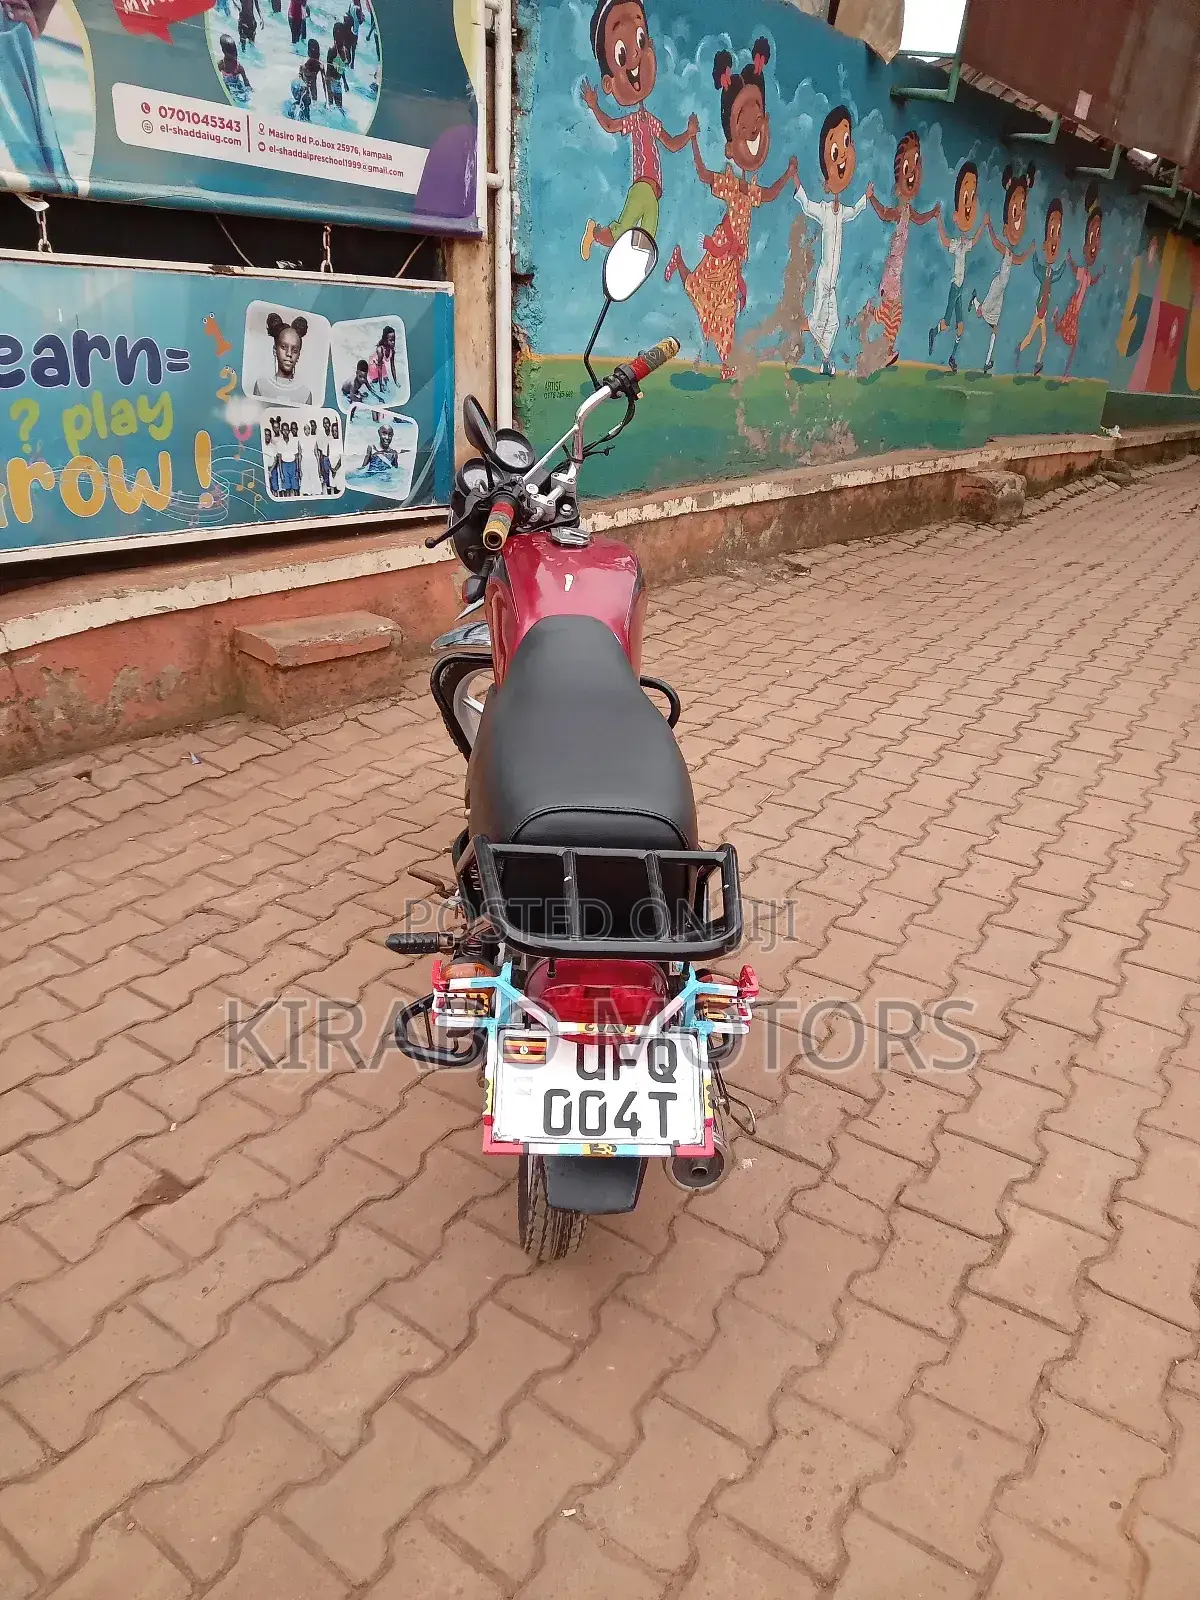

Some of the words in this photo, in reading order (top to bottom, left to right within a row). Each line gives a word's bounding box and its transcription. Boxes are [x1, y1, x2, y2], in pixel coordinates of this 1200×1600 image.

[158, 105, 241, 133] 0701045343
[159, 123, 242, 147] el-shaddaiug.com
[268, 128, 295, 142] Masiro
[296, 134, 307, 144] Rd
[308, 137, 335, 150] P.o.box
[336, 143, 361, 157] 25976,
[362, 148, 393, 162] kampala
[268, 144, 404, 178] el-shaddaipreschool1999@gmail.com
[62, 390, 174, 457] play
[542, 1088, 678, 1139] 004T
